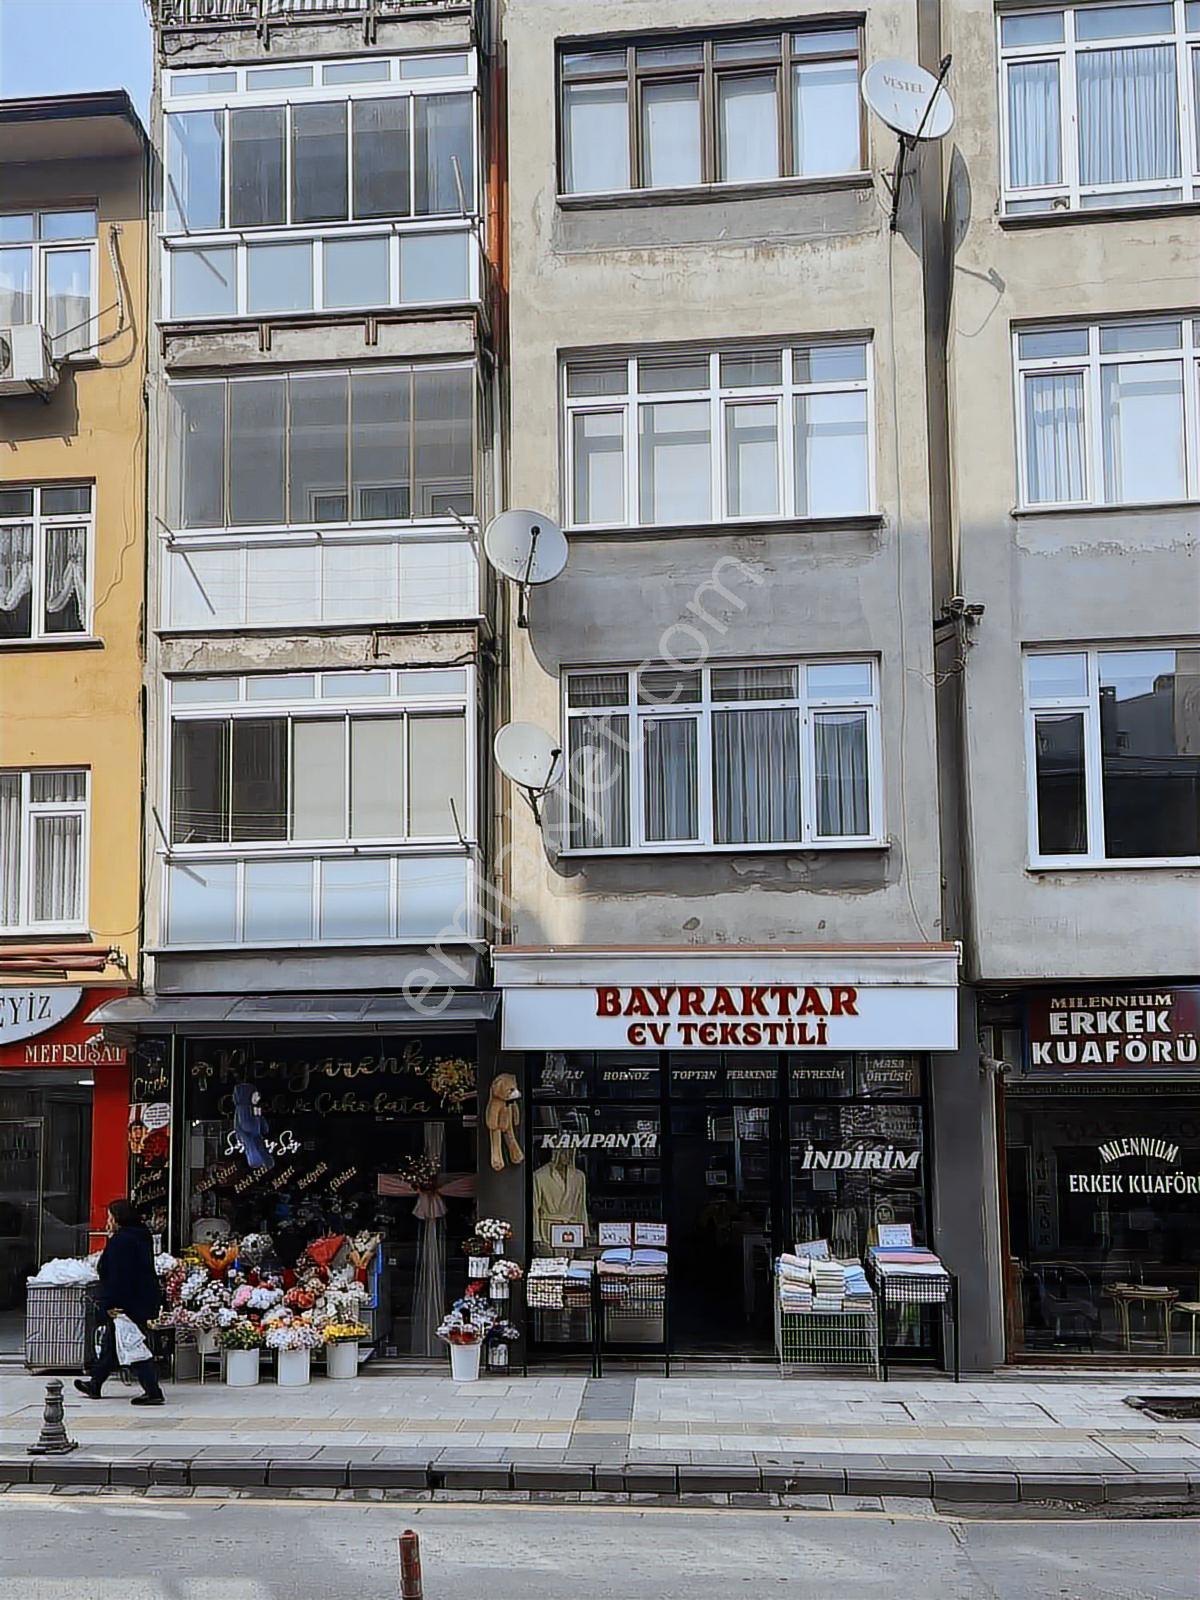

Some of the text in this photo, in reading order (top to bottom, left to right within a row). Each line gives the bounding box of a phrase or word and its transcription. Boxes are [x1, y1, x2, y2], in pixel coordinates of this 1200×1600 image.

[883, 75, 925, 94] VESTEL
[595, 985, 860, 1017] BAYRAKTAR
[1051, 994, 1174, 1009] MILENNIUM
[627, 1017, 829, 1046] EV TEKSTİLİ
[1049, 1010, 1172, 1036] ERKEK
[1031, 1033, 1198, 1065] KUAFÖRÜ
[791, 1067, 845, 1080] NEVRESİM
[872, 1058, 905, 1069] MASA
[672, 1070, 717, 1080] TOPTAN
[726, 1069, 778, 1080] PERAKENDE
[541, 1133, 658, 1149] KAMPANYA
[1098, 1137, 1179, 1163] MILENNIUM
[800, 1145, 922, 1170] İNDİRİM
[1069, 1171, 1200, 1194] ERKEK KUAFÖR
